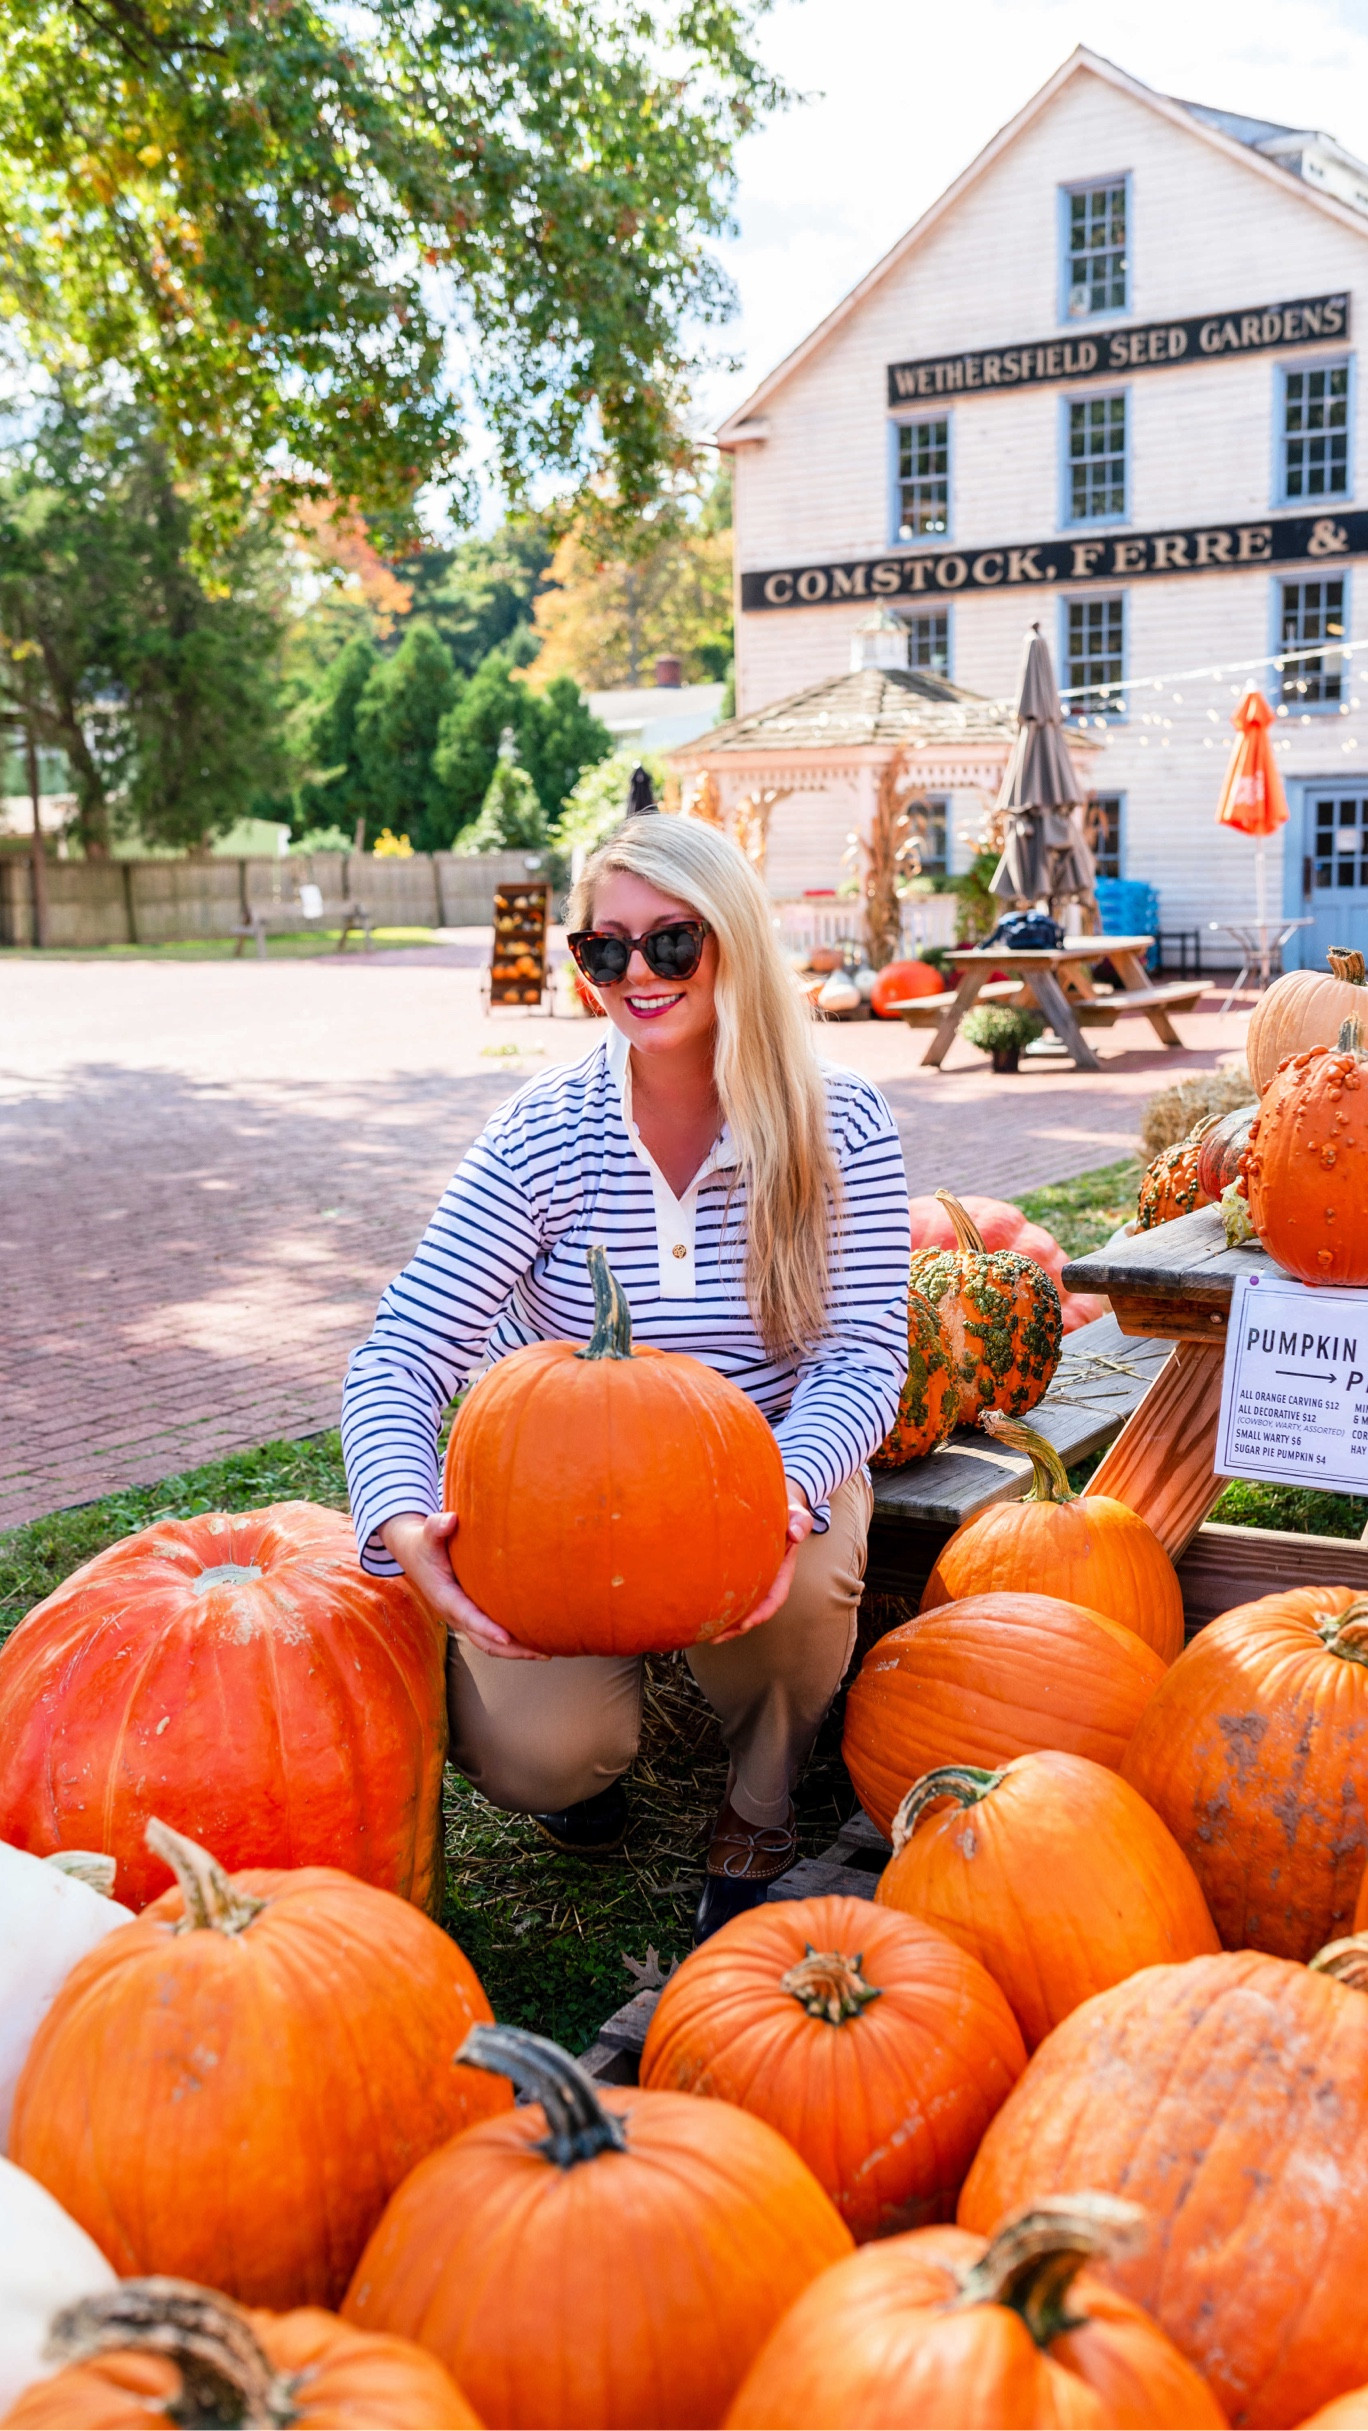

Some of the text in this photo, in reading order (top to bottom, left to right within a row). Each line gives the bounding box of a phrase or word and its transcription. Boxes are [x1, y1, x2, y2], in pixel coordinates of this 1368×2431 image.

[894, 301, 1344, 397] WETHERSFIELD SEED GARDENS
[764, 518, 1350, 604] COMSTOCK, FERRE &
[1247, 1327, 1357, 1363] PUMPKIN
[1346, 1370, 1368, 1393] P
[1240, 1389, 1340, 1410] ALL ORANGE CARVING $12
[1238, 1404, 1317, 1423] ALL DECORATIVE $12
[1236, 1428, 1302, 1446] SMALL WARTY $6
[1237, 1416, 1346, 1437] (COWBOY, WARTY, ASSORTED)
[1234, 1443, 1326, 1465] SUGAR PIE PUMPKIN $4
[1351, 1445, 1367, 1455] HAY
